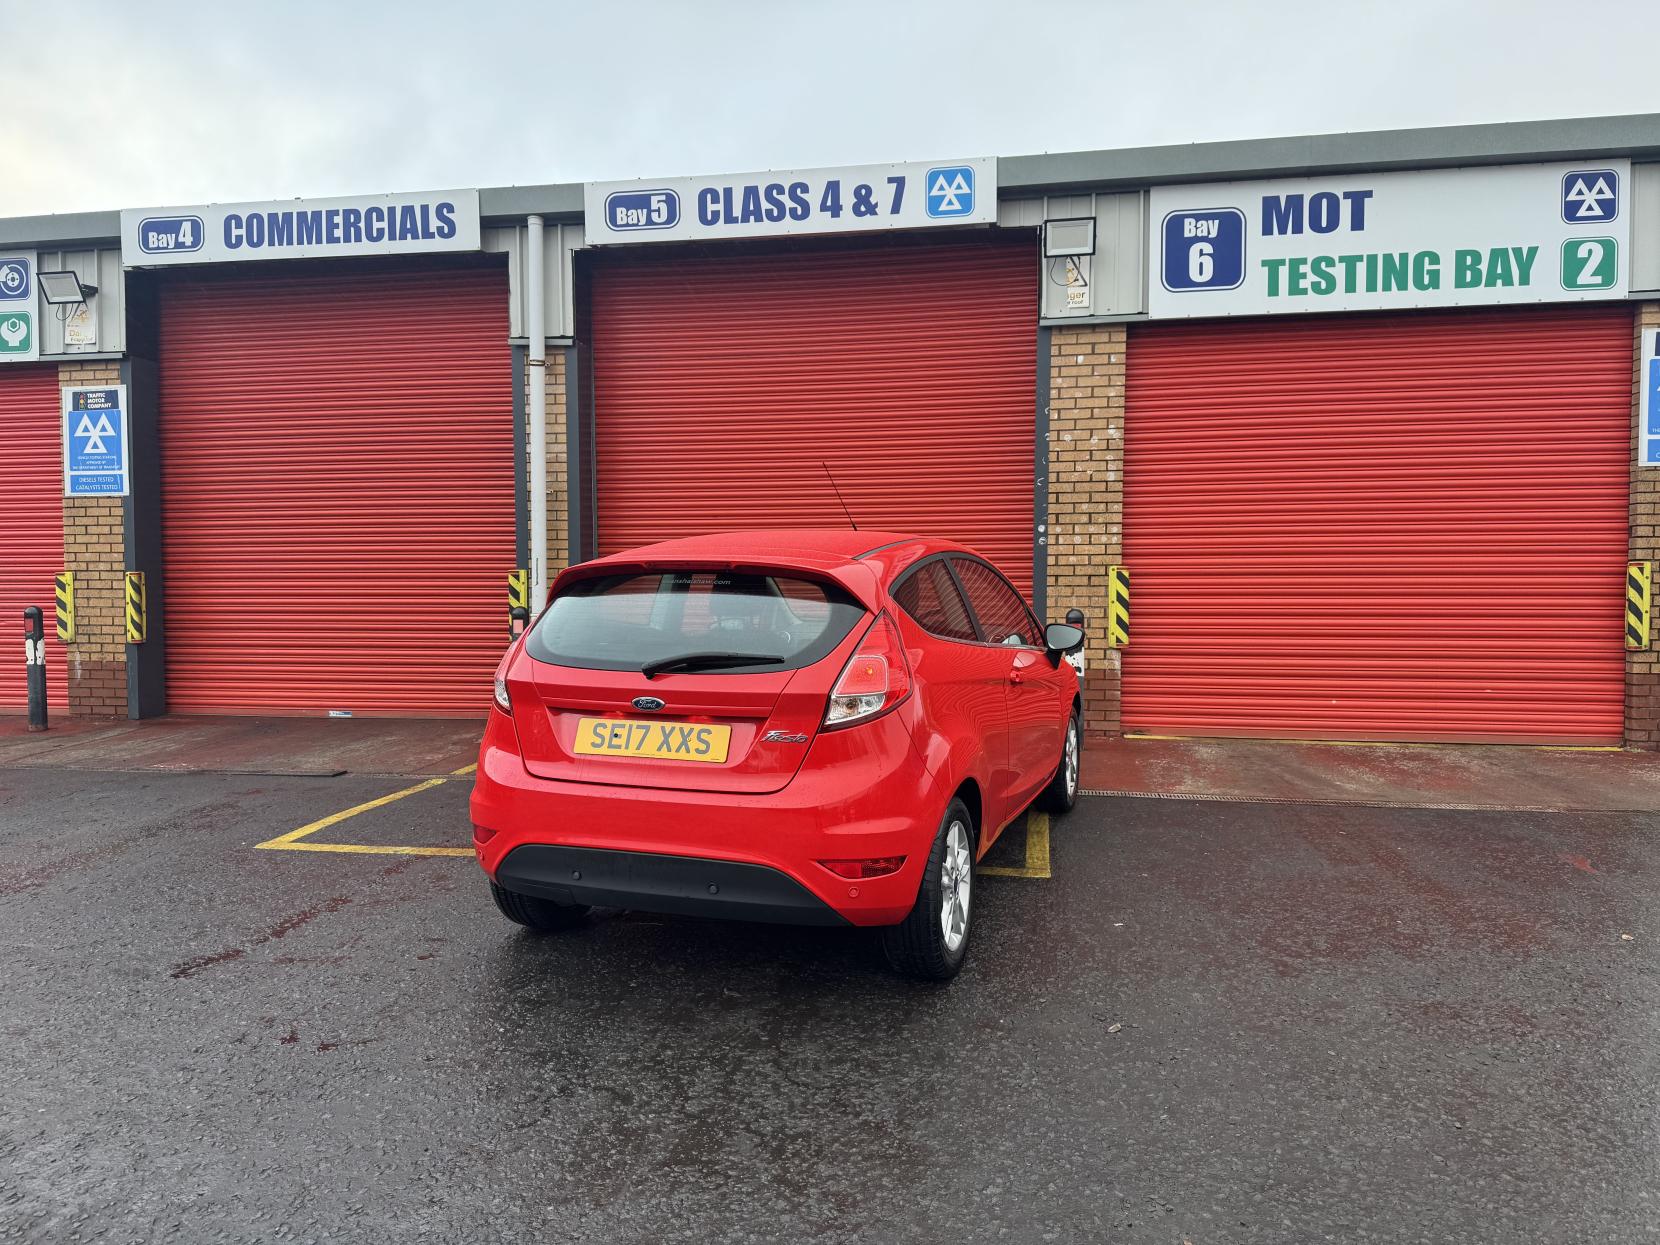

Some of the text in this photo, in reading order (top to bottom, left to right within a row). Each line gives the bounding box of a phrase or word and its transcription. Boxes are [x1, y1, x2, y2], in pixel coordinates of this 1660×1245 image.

[615, 194, 668, 227] Bay 5
[698, 176, 906, 226] CLASS 4 & 7
[1261, 190, 1374, 236] MOT
[148, 221, 194, 250] Bay 4
[223, 202, 457, 250] COMMERCIALS
[1183, 217, 1220, 239] Bay
[1188, 242, 1214, 283] 6
[1261, 245, 1539, 298] TESTING BAY
[1577, 242, 1604, 285] 2
[656, 725, 713, 755] XXS
